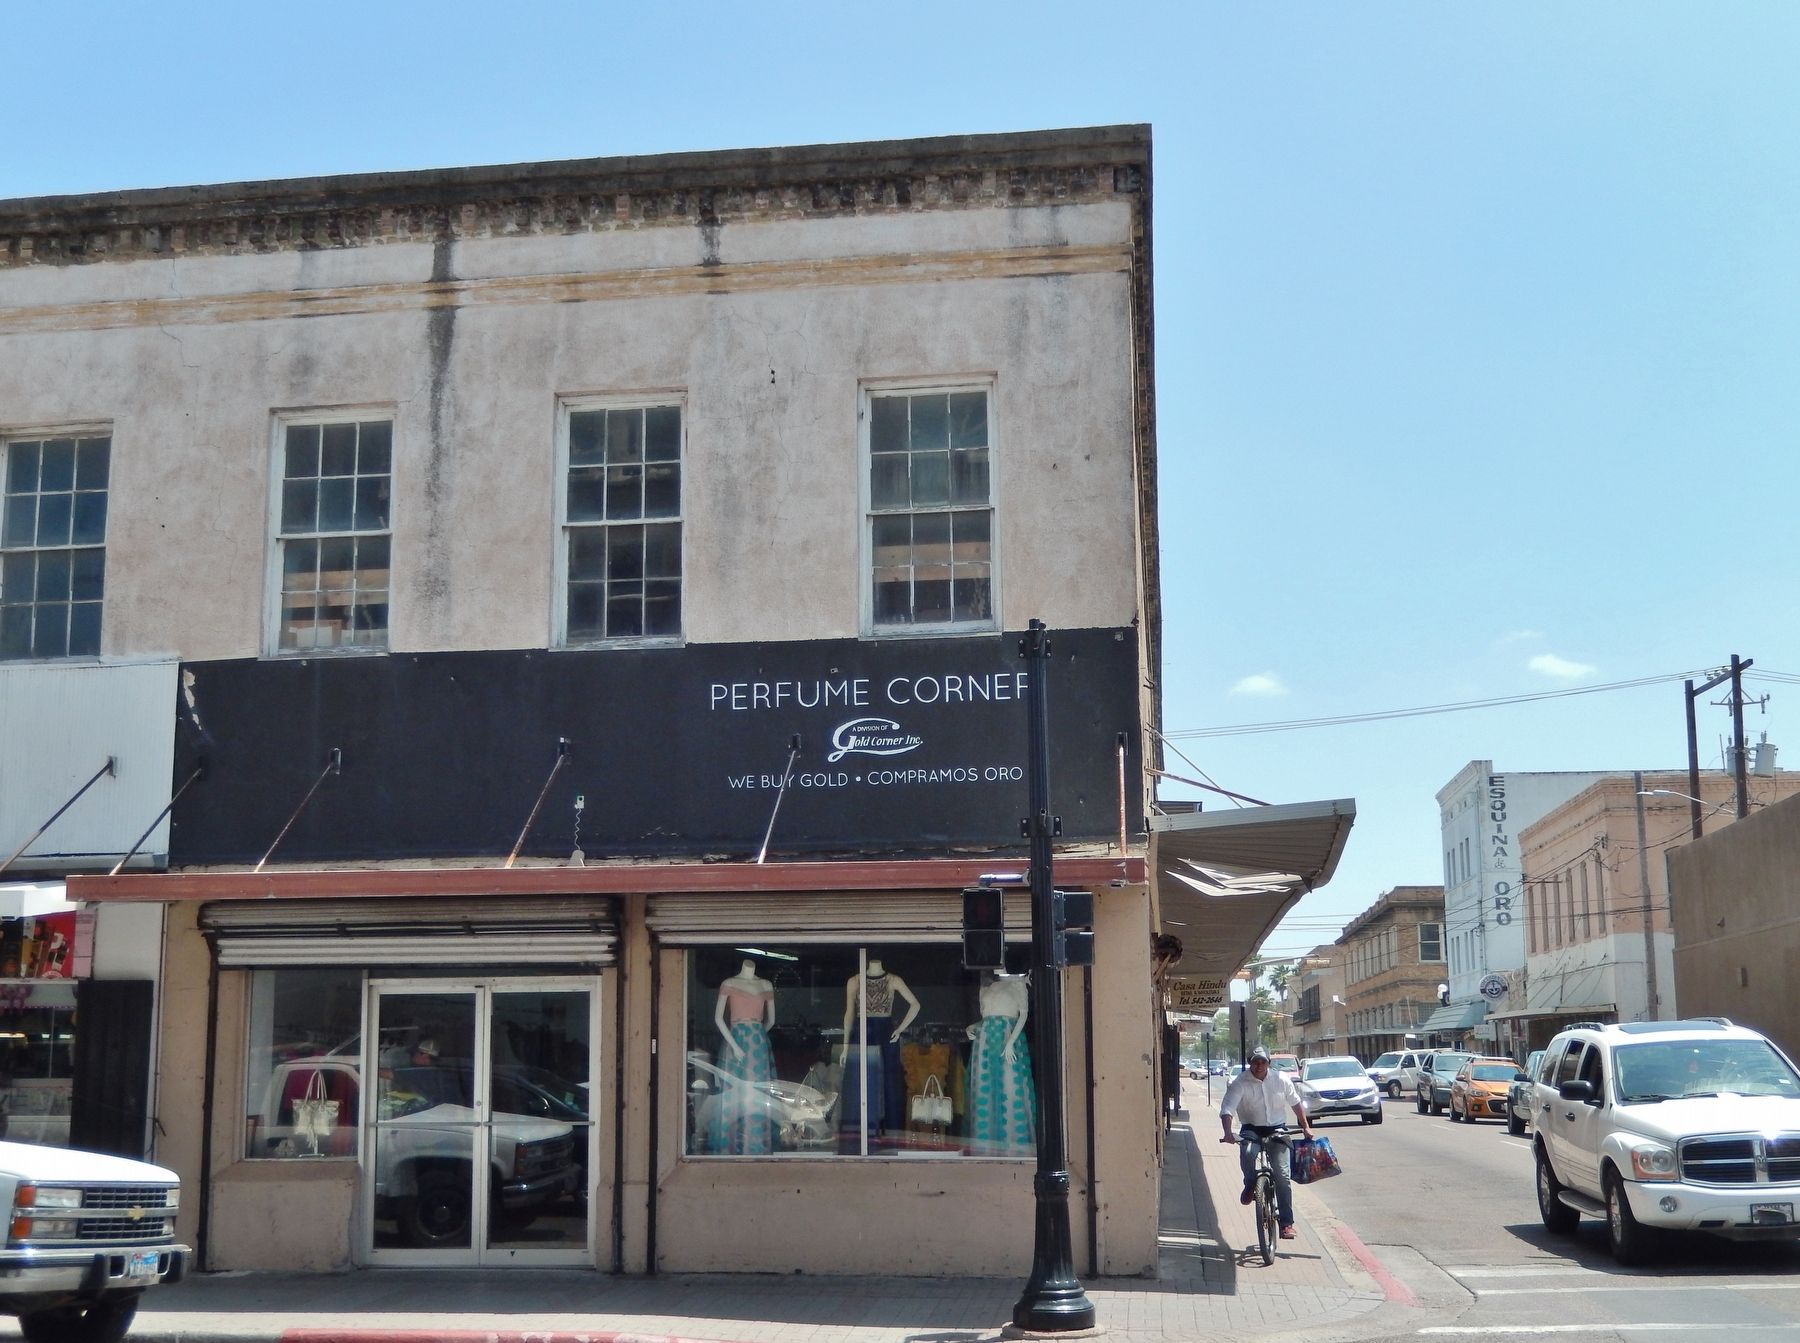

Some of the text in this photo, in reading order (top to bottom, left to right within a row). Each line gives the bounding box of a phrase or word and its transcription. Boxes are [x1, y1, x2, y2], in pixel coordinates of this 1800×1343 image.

[710, 678, 870, 711] PERFUME
[871, 736, 904, 746] Corner
[905, 734, 924, 745] Inc.
[728, 766, 1024, 789] WE BUY GOLD COMPRAMOS ORO
[1488, 776, 1508, 857] ESQUINA
[1494, 881, 1512, 926] ORO
[1173, 979, 1227, 991] Casa Hindu
